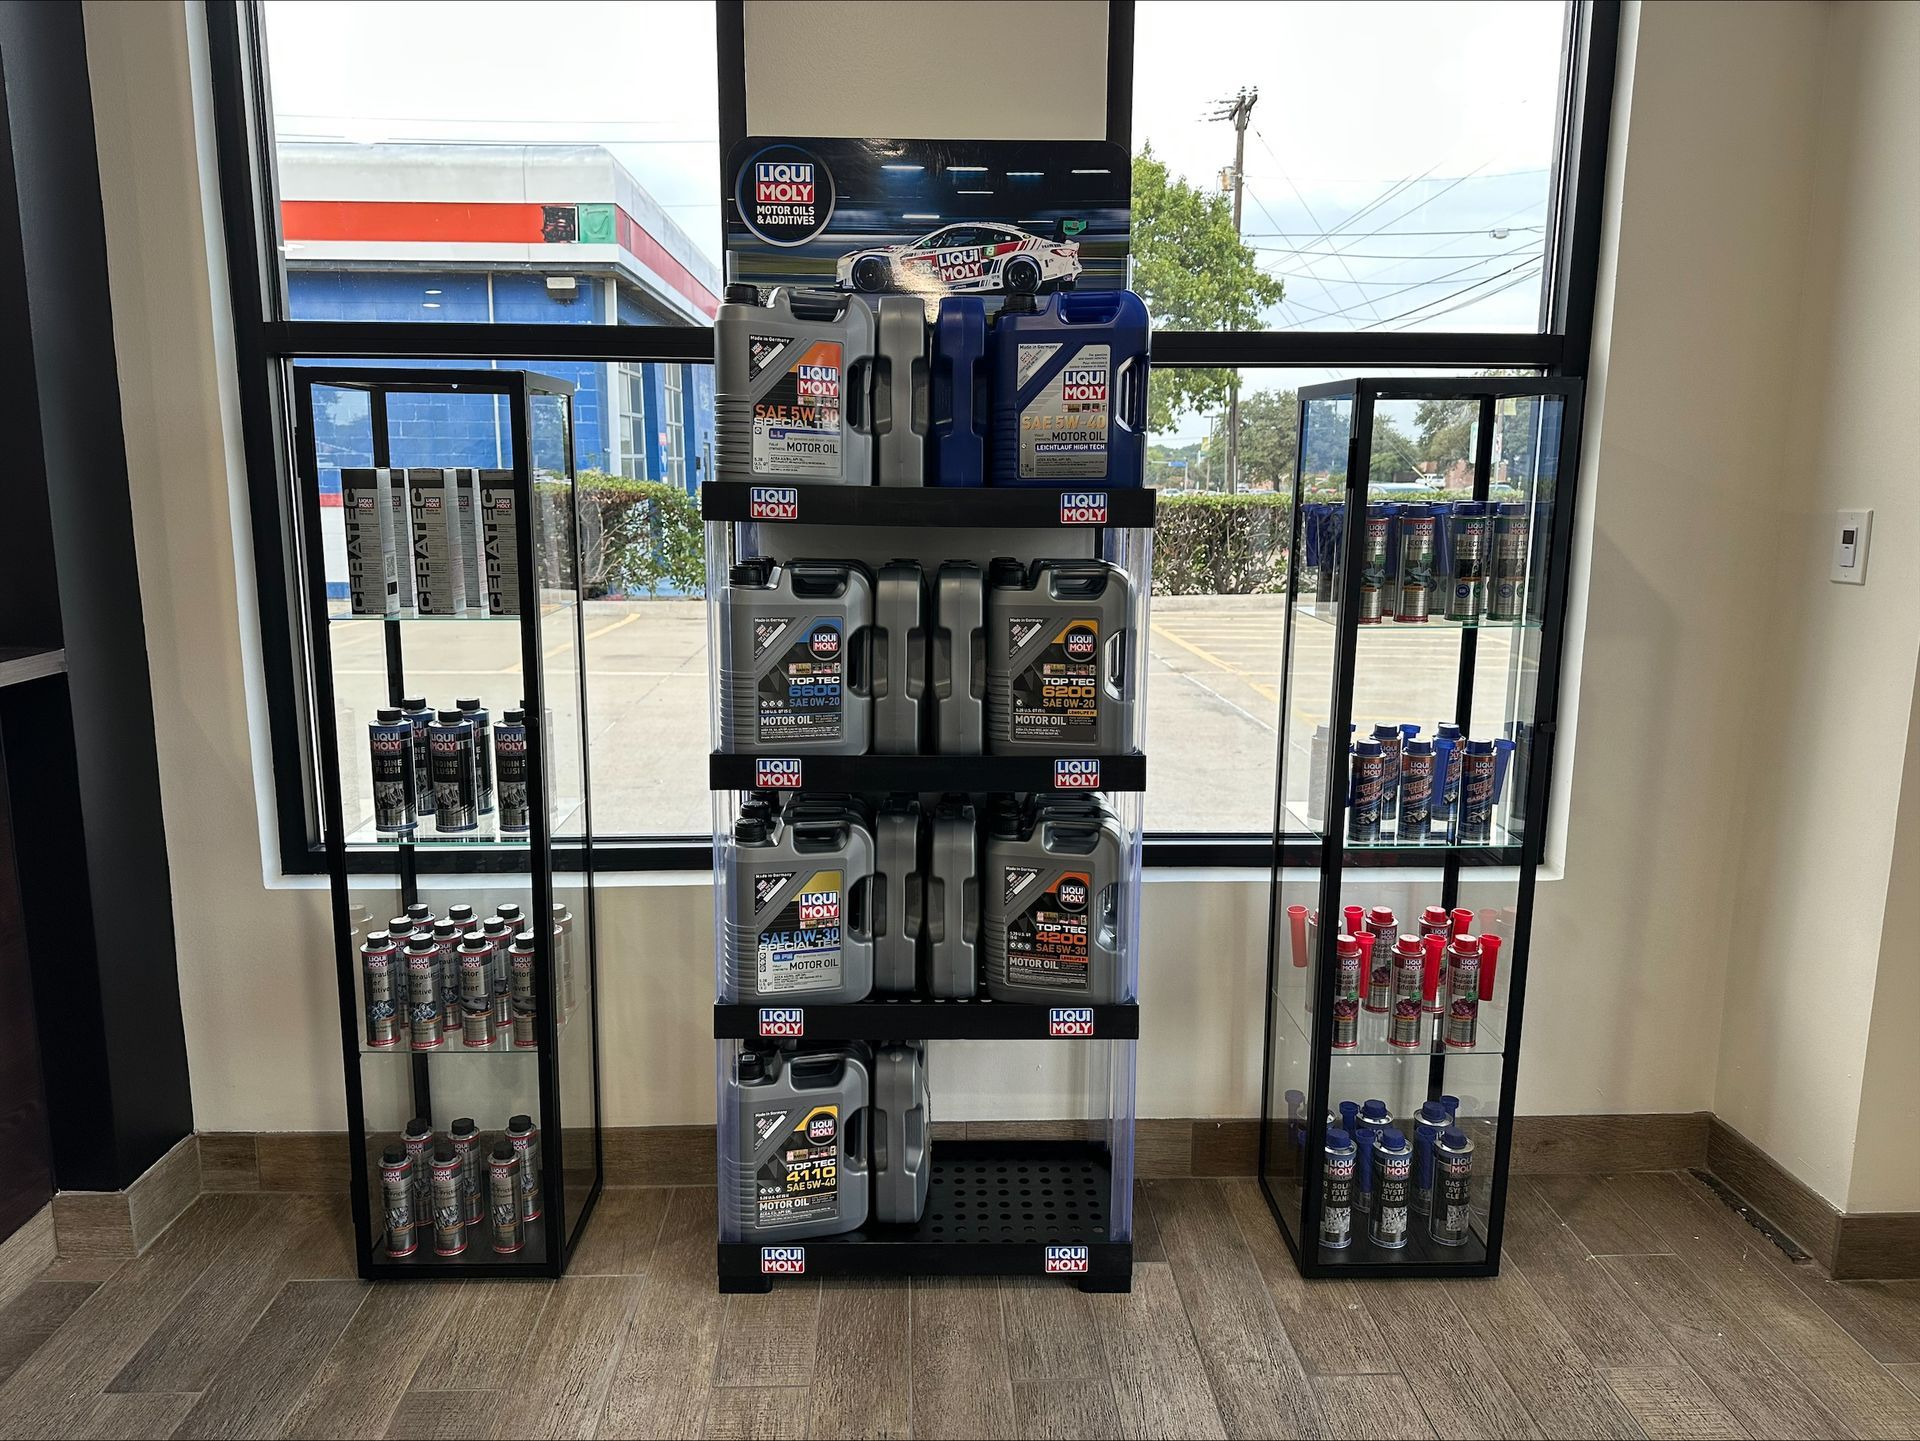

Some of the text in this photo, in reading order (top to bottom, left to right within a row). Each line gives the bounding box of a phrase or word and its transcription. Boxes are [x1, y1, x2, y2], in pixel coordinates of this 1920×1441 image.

[759, 165, 811, 182] LIQUI
[759, 184, 813, 201] MOLY
[757, 206, 815, 216] MOTOR OILS
[765, 215, 815, 225] ADDITIVES
[938, 250, 979, 267] LIQUI
[941, 263, 981, 281] MOLY
[800, 366, 836, 381] LIQUI
[1065, 371, 1105, 385] LIQUI
[800, 380, 837, 395] MOLY
[1064, 386, 1105, 400] MOLY
[756, 403, 839, 422] SAE 5W-30
[753, 417, 841, 430] SPECIAL TEC
[1022, 415, 1106, 430] SAE 5W-40
[770, 430, 784, 438] LL
[1052, 431, 1087, 441] MOTOR
[1089, 431, 1105, 441] OIL
[786, 442, 820, 453] MOTOR
[823, 443, 838, 453] OIL
[754, 490, 796, 504] LIQUI
[1063, 496, 1104, 508] LIQUI
[754, 503, 795, 517] MOLY
[1063, 508, 1104, 521] MOLY
[345, 488, 366, 612] CERATEC
[411, 488, 433, 612] CERATEC
[482, 489, 503, 612] CERATEC
[814, 633, 837, 642] LIQUI
[1069, 635, 1092, 643] LIQUI
[814, 642, 838, 651] MOLY
[1069, 643, 1093, 652] MOLY
[789, 676, 840, 685] TOP TEC
[788, 684, 840, 697] 6600
[1042, 686, 1095, 698] 6200
[790, 697, 840, 707] SAE 0W-20
[1043, 698, 1095, 708] SAE 0W-20
[760, 715, 795, 726] MOTOR
[797, 715, 813, 724] OIL
[1015, 715, 1049, 725] MOTOR
[1050, 716, 1066, 725] OIL
[373, 733, 399, 741] LIQUI
[431, 734, 454, 742] LIQUI
[497, 734, 522, 742] LIQUI
[373, 741, 400, 750] MOLY
[431, 742, 455, 751] MOLY
[497, 742, 522, 751] MOLY
[759, 761, 798, 774] LIQUI
[1057, 761, 1096, 774] LIQUI
[1410, 768, 1430, 776] MOLY
[759, 773, 799, 785] MOLY
[1057, 774, 1097, 786] MOLY
[1062, 886, 1084, 895] LIQUI
[801, 893, 836, 905] LIQUI
[1062, 894, 1085, 903] MOLY
[801, 905, 838, 918] MOLY
[1036, 923, 1087, 934] TOP TEC
[760, 928, 839, 945] SAE 0W-30
[1036, 931, 1087, 945] 4200
[758, 939, 840, 952] SPECIAL TEC
[1036, 944, 1055, 953] SAE
[1056, 945, 1087, 955] 5W-30
[789, 959, 822, 971] MOTOR
[824, 959, 838, 968] OIL
[1009, 957, 1042, 968] MOTOR
[1043, 959, 1059, 970] OIL
[762, 1011, 800, 1024] LIQUI
[1052, 1011, 1090, 1024] LIQUI
[762, 1022, 801, 1035] MOLY
[1052, 1022, 1091, 1034] MOLY
[811, 1120, 833, 1129] LIQUI
[810, 1128, 834, 1138] MOLY
[787, 1159, 836, 1171] TOP TEC
[1330, 1159, 1353, 1167] LIQUI
[1387, 1159, 1410, 1167] LIQUI
[786, 1166, 836, 1182] 4110
[1329, 1167, 1353, 1176] MOLY
[1386, 1167, 1410, 1176] MOLY
[786, 1178, 836, 1192] SAE 5W-40
[760, 1199, 793, 1211] MOTOR
[795, 1198, 809, 1207] OIL
[764, 1250, 802, 1260] LIQUI
[1048, 1249, 1086, 1260] LIQUI
[764, 1260, 802, 1272] MOLY
[1048, 1260, 1086, 1271] MOLY
